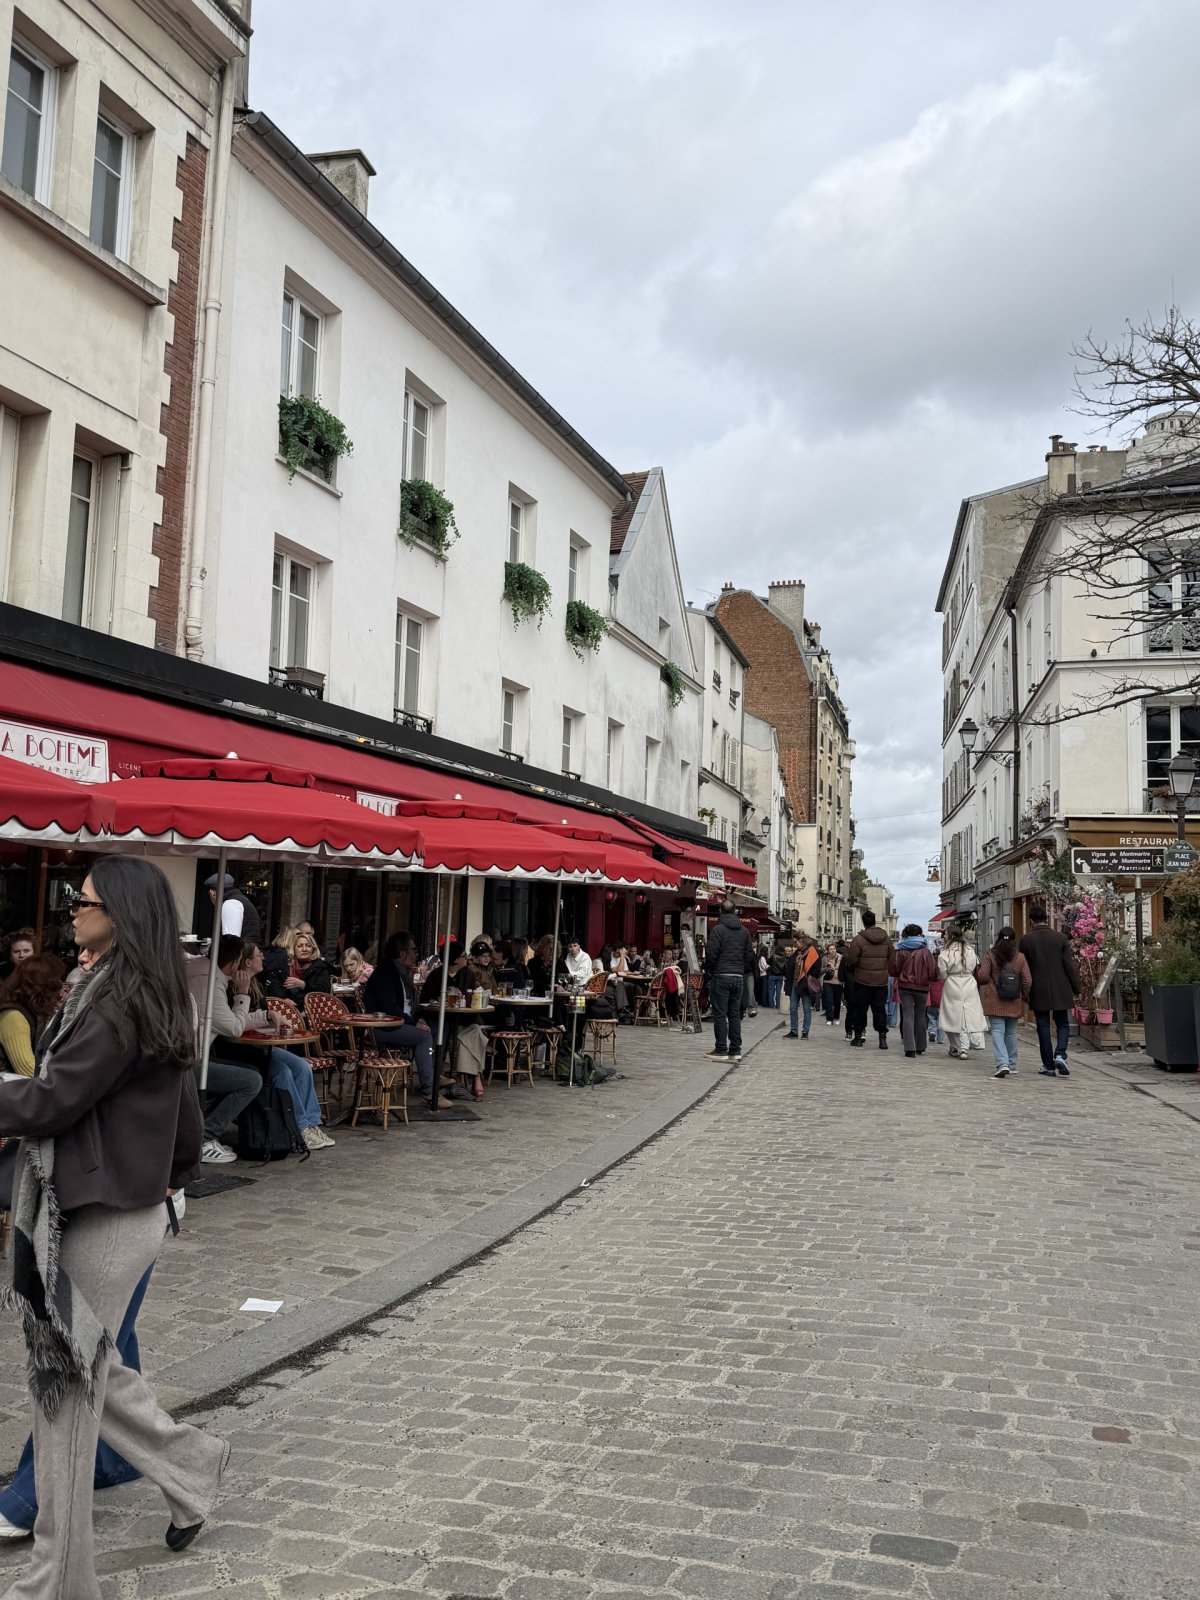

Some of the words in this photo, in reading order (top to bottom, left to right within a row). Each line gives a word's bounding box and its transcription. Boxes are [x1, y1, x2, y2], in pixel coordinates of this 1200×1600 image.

[1, 731, 14, 754] A
[26, 734, 101, 769] BOHEME
[118, 762, 142, 772] LICENC
[1091, 851, 1107, 859] Vigne
